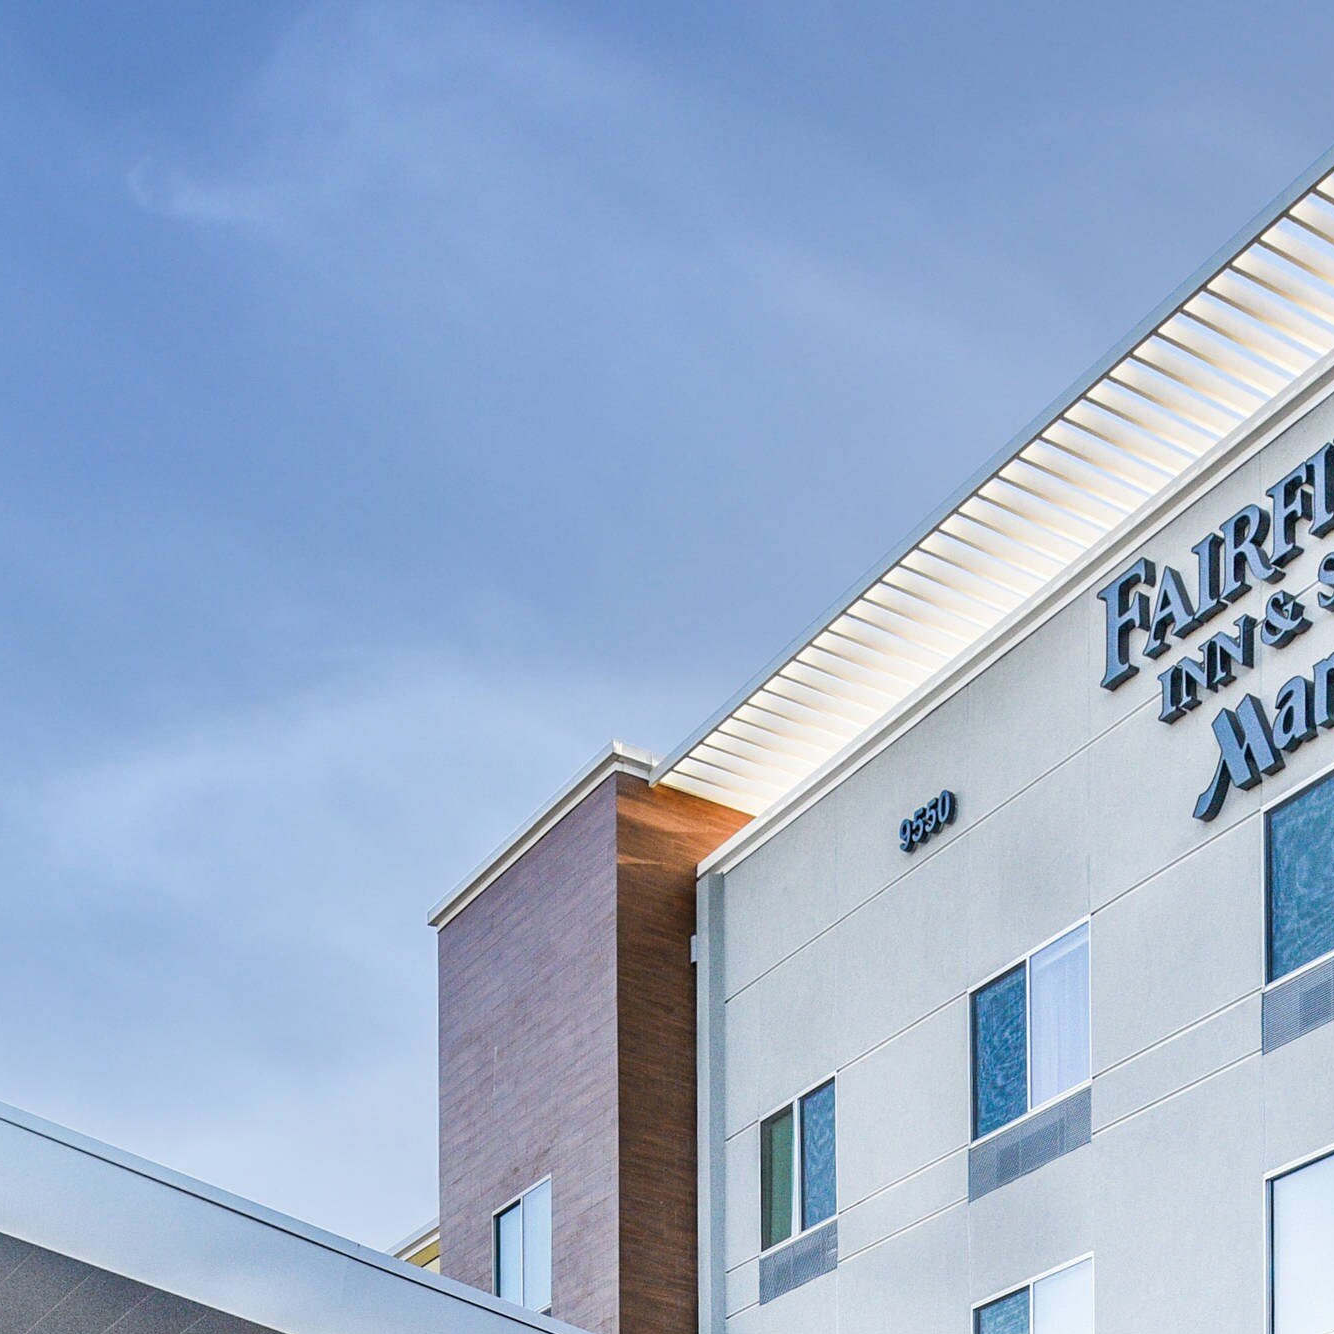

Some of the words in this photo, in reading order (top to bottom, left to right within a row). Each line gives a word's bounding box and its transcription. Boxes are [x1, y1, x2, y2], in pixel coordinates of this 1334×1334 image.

[1158, 613, 1257, 725] INN
[1261, 589, 1314, 649] &
[899, 789, 957, 853] 9550
